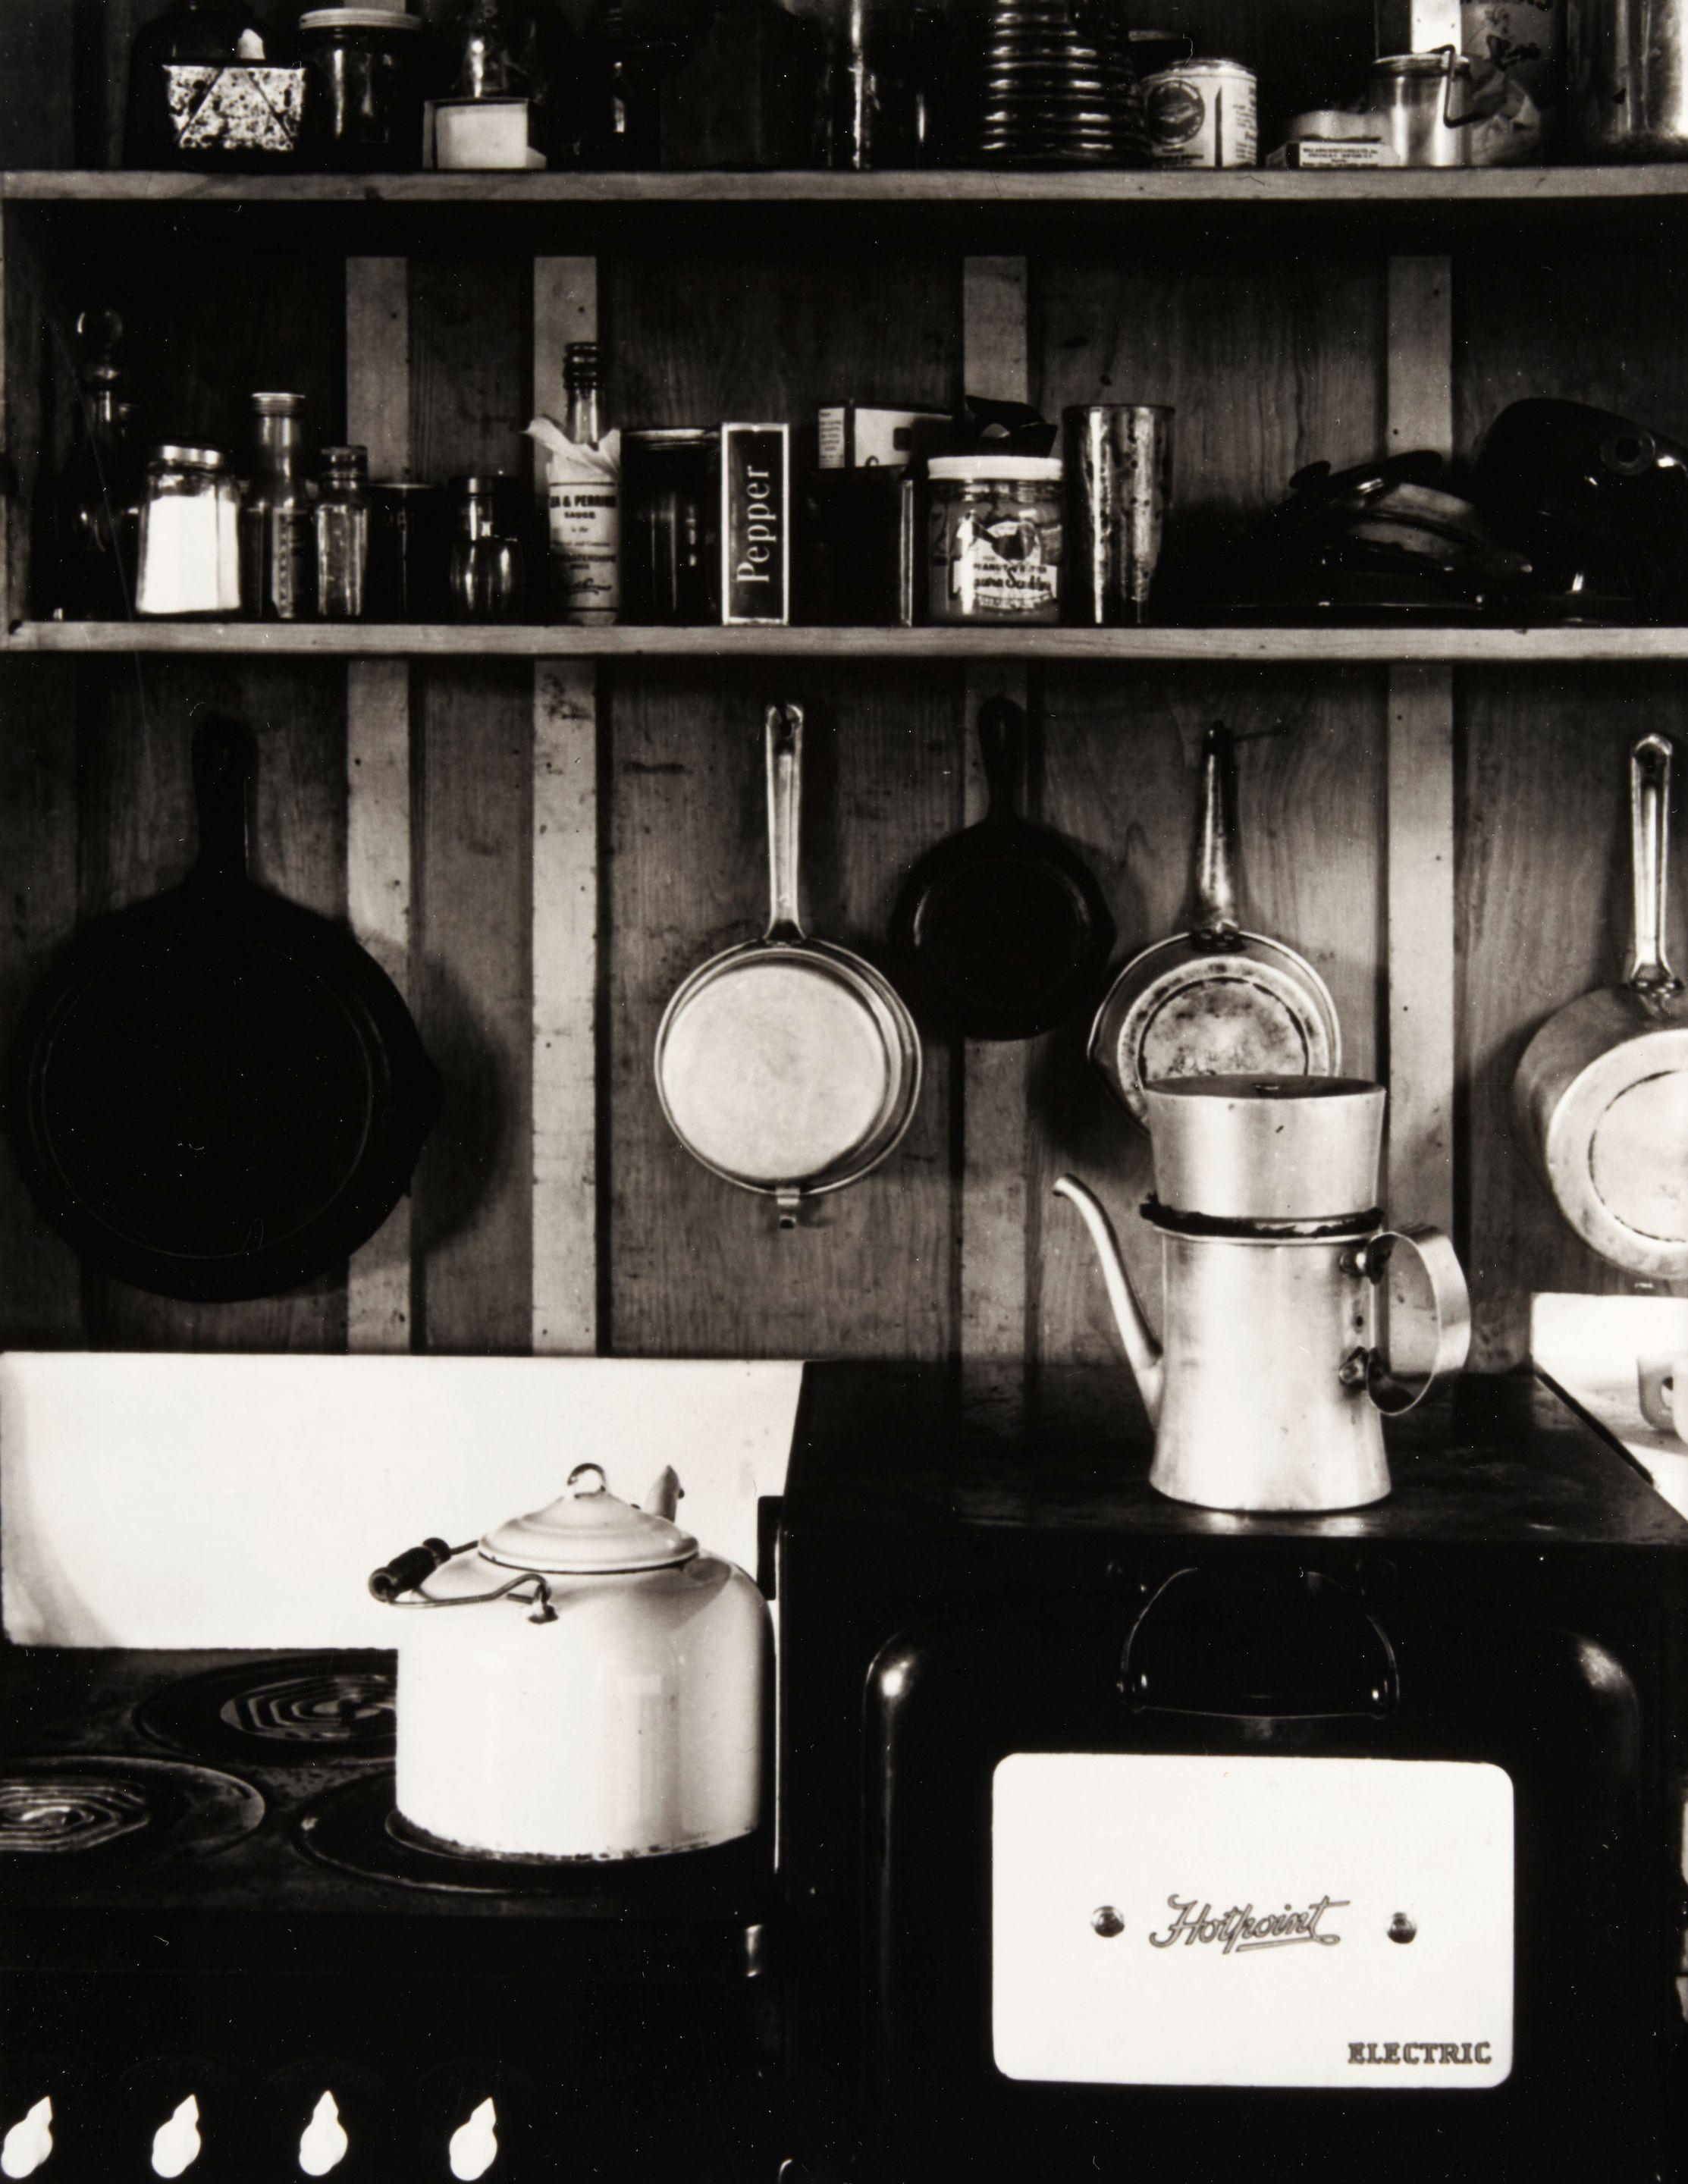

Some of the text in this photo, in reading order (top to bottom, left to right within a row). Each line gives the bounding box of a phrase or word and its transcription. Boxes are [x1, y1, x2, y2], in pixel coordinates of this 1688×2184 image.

[736, 465, 777, 582] Pepper
[1149, 1894, 1351, 1954] Hotpoint
[1348, 2041, 1492, 2065] ELECTRIC
